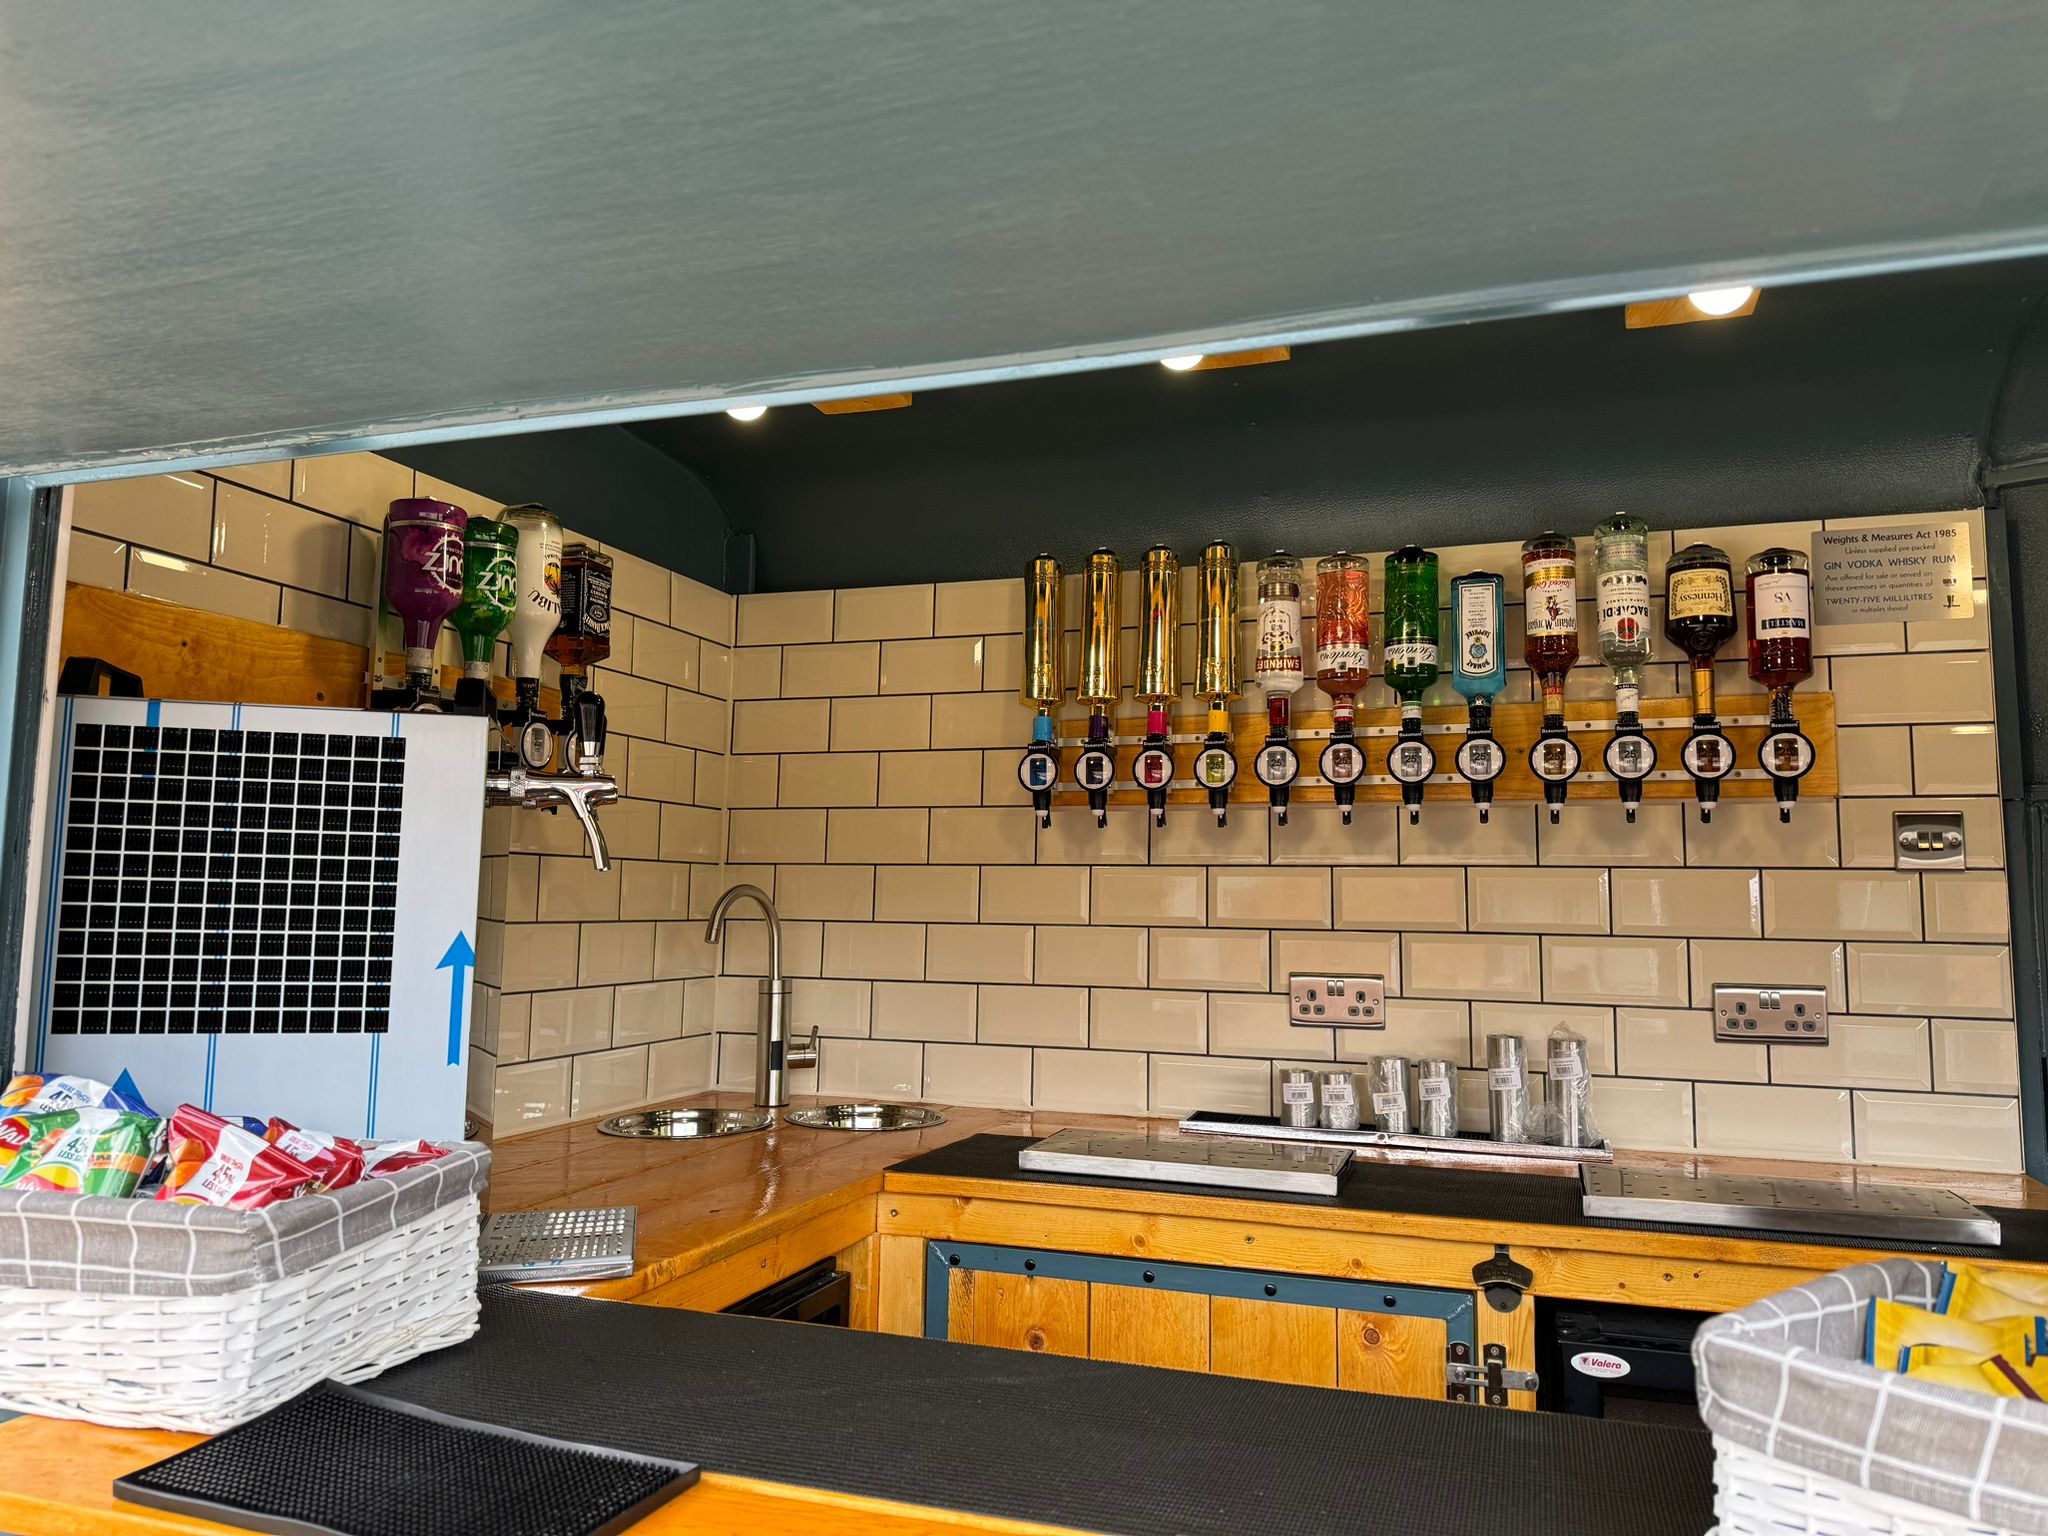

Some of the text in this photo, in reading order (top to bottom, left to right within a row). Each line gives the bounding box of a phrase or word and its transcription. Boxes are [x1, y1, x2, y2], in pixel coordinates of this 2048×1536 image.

[1823, 529, 1957, 546] Weights & Measures Act 1985
[1844, 547, 1867, 555] Unless
[1869, 545, 1897, 554] supplied
[1823, 554, 1957, 571] GIN VODKA WHISKY RUM
[1824, 574, 1838, 582] Are
[1840, 572, 1864, 581] offered
[1865, 572, 1874, 580] for
[1877, 571, 1889, 579] sale
[1900, 570, 1922, 578] served
[1530, 579, 1572, 592] Spiced Gold
[1824, 584, 1844, 592] these
[1846, 584, 1877, 592] premises
[1889, 580, 1923, 590] quantities
[1926, 579, 1933, 587] of
[1679, 592, 1723, 603] Hennessy
[1773, 591, 1793, 604] VS
[1825, 592, 1934, 606] TWENTY-FIVE MILLILITRES
[1860, 605, 1886, 614] multiples
[1887, 604, 1909, 613] thereof
[1527, 617, 1577, 631] Captain Morgan
[1465, 629, 1491, 640] SAPPHIRE
[1319, 650, 1366, 666] Gordon's
[1387, 645, 1435, 661] Gordon's
[1256, 659, 1300, 670] SMIRNOFF
[1466, 658, 1491, 670] BOMBAY
[1336, 756, 1348, 765] 25
[1405, 754, 1417, 763] 25
[1474, 752, 1486, 761] 25
[1624, 750, 1637, 759] 25
[1210, 761, 1221, 769] 25
[1271, 758, 1282, 767] 25
[58, 1150, 74, 1160] LESS
[201, 1178, 217, 1192] LESS
[1591, 1358, 1622, 1370] Valera
